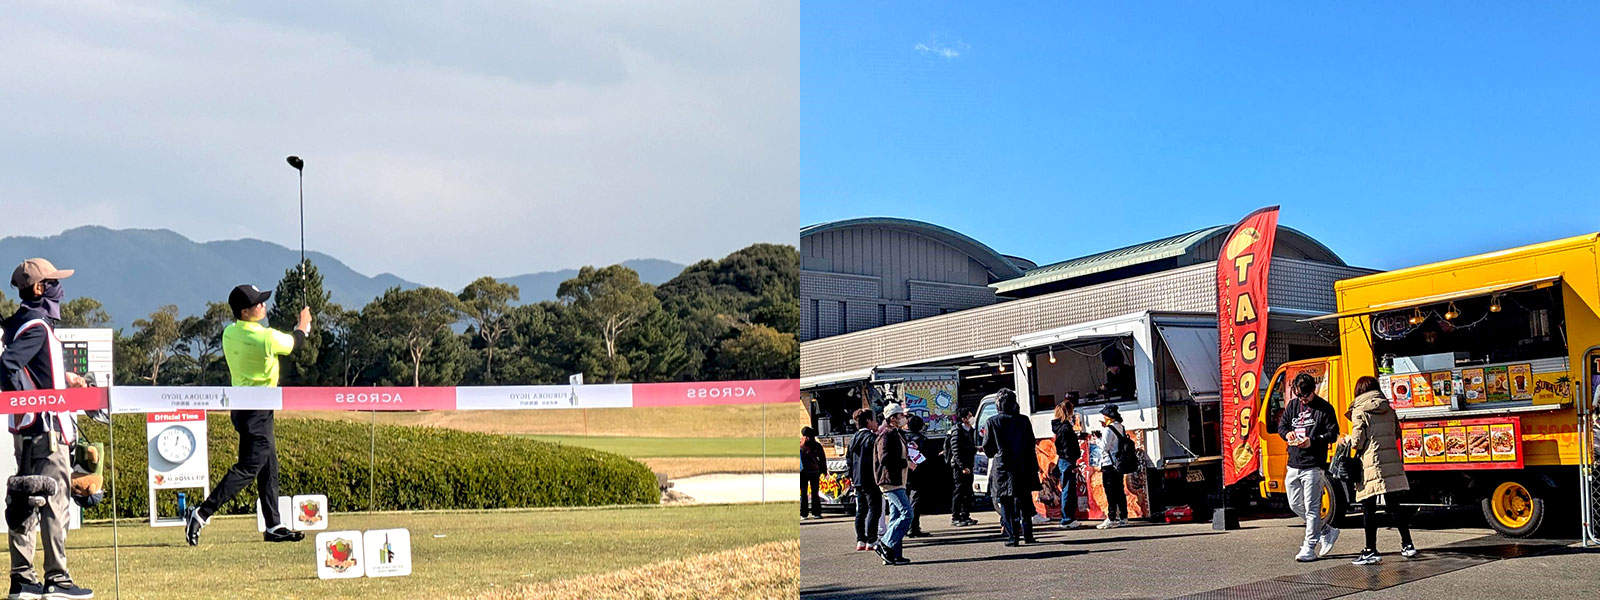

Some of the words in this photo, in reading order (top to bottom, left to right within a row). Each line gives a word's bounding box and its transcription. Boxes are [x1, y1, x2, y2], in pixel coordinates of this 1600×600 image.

[1235, 253, 1258, 440] TACOS
[1230, 349, 1239, 405] YELLOW
[154, 414, 181, 422] Official
